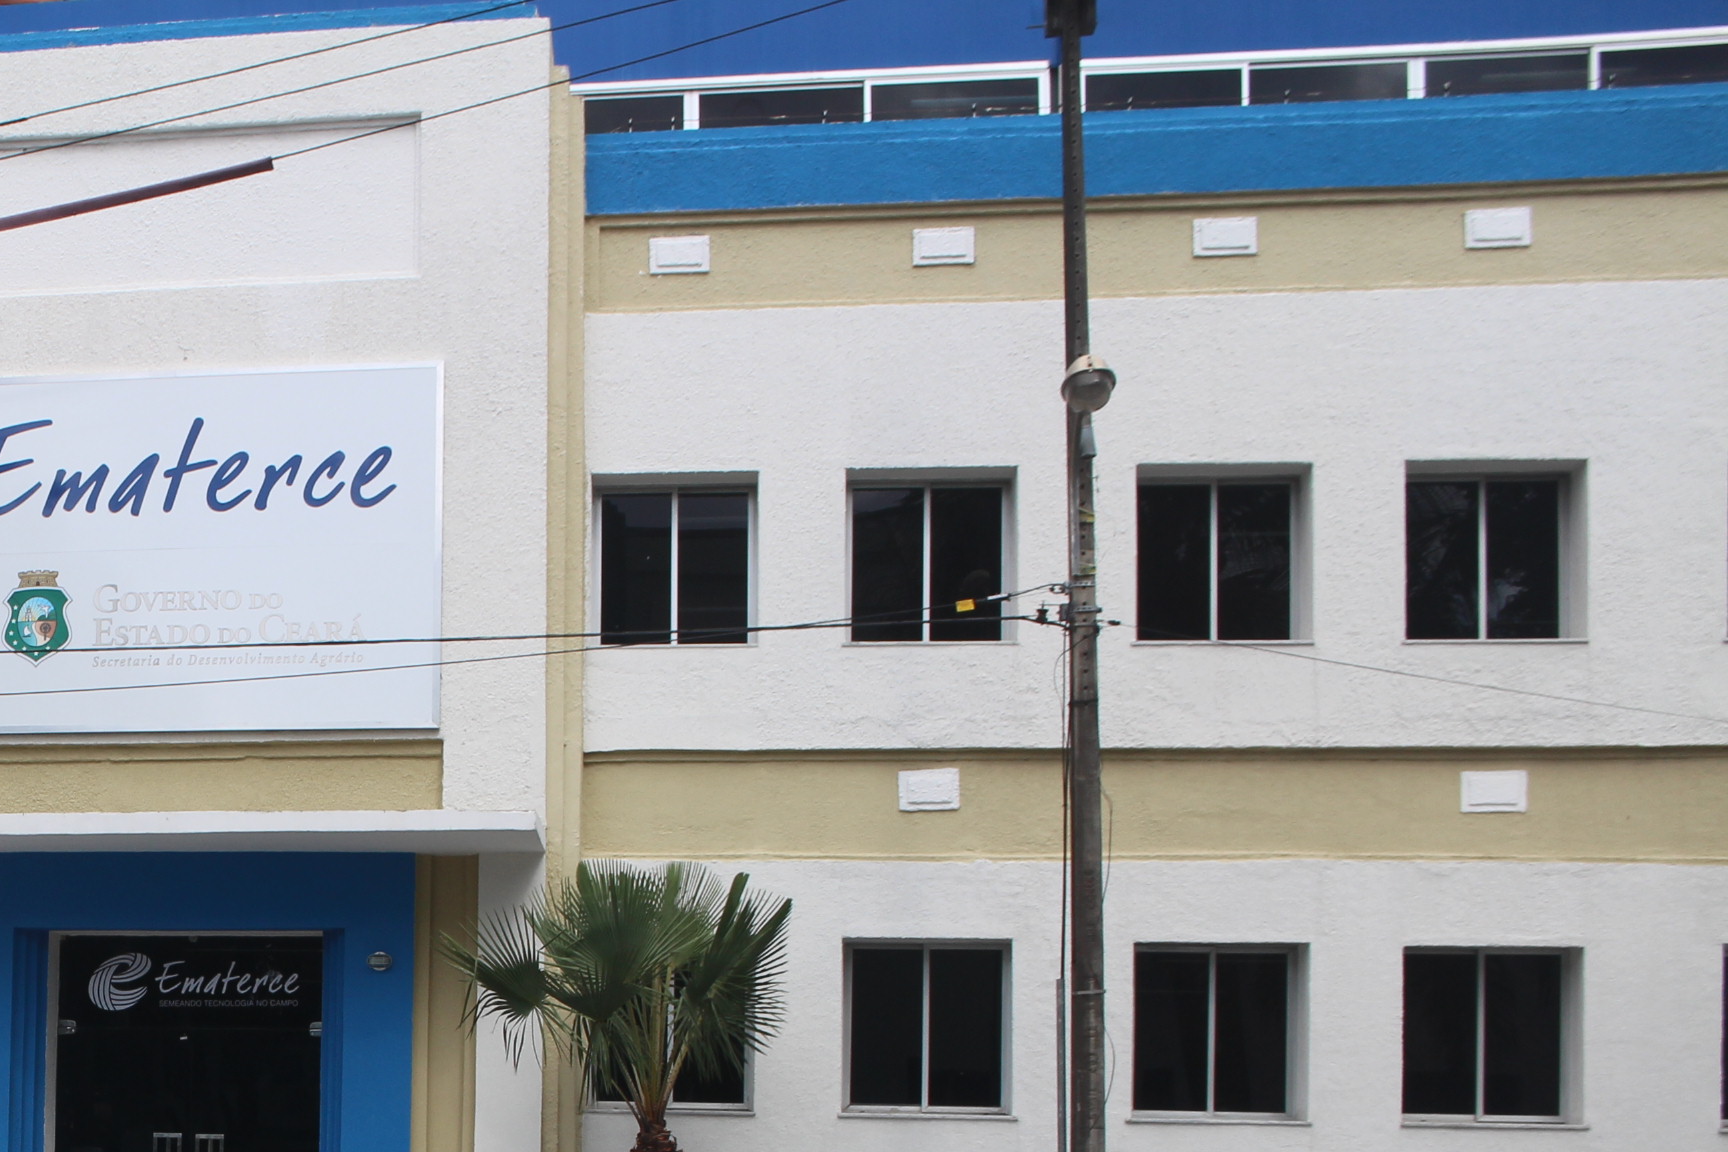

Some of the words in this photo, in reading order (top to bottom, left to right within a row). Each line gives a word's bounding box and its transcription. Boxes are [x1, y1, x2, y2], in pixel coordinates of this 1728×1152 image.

[92, 653, 160, 668] Secretaria
[166, 653, 183, 666] do
[188, 652, 306, 666] Desenvolvimento
[310, 652, 364, 668] Agrário
[155, 960, 300, 995] Ematerce
